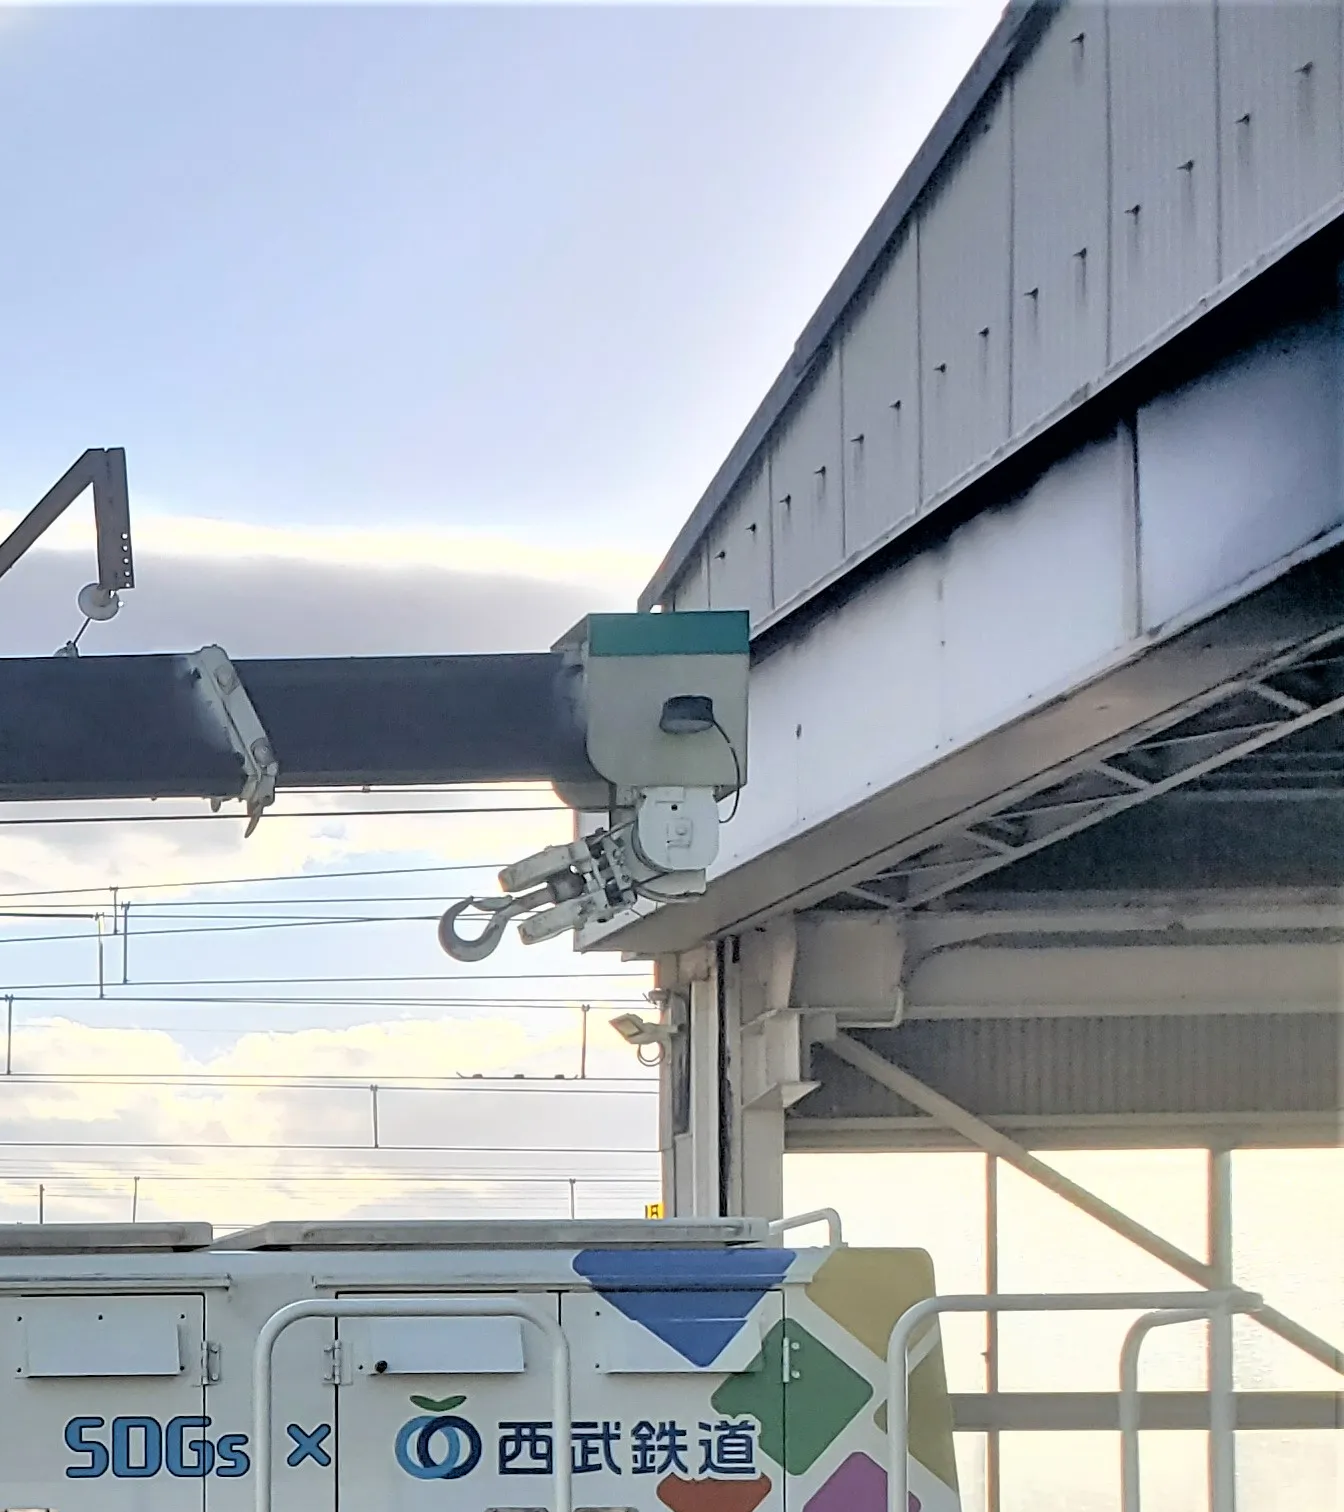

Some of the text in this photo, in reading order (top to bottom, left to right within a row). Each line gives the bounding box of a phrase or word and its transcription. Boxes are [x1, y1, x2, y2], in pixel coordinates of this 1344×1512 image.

[64, 1416, 251, 1478] SDGs
[498, 1420, 756, 1476] 西武鉄道
